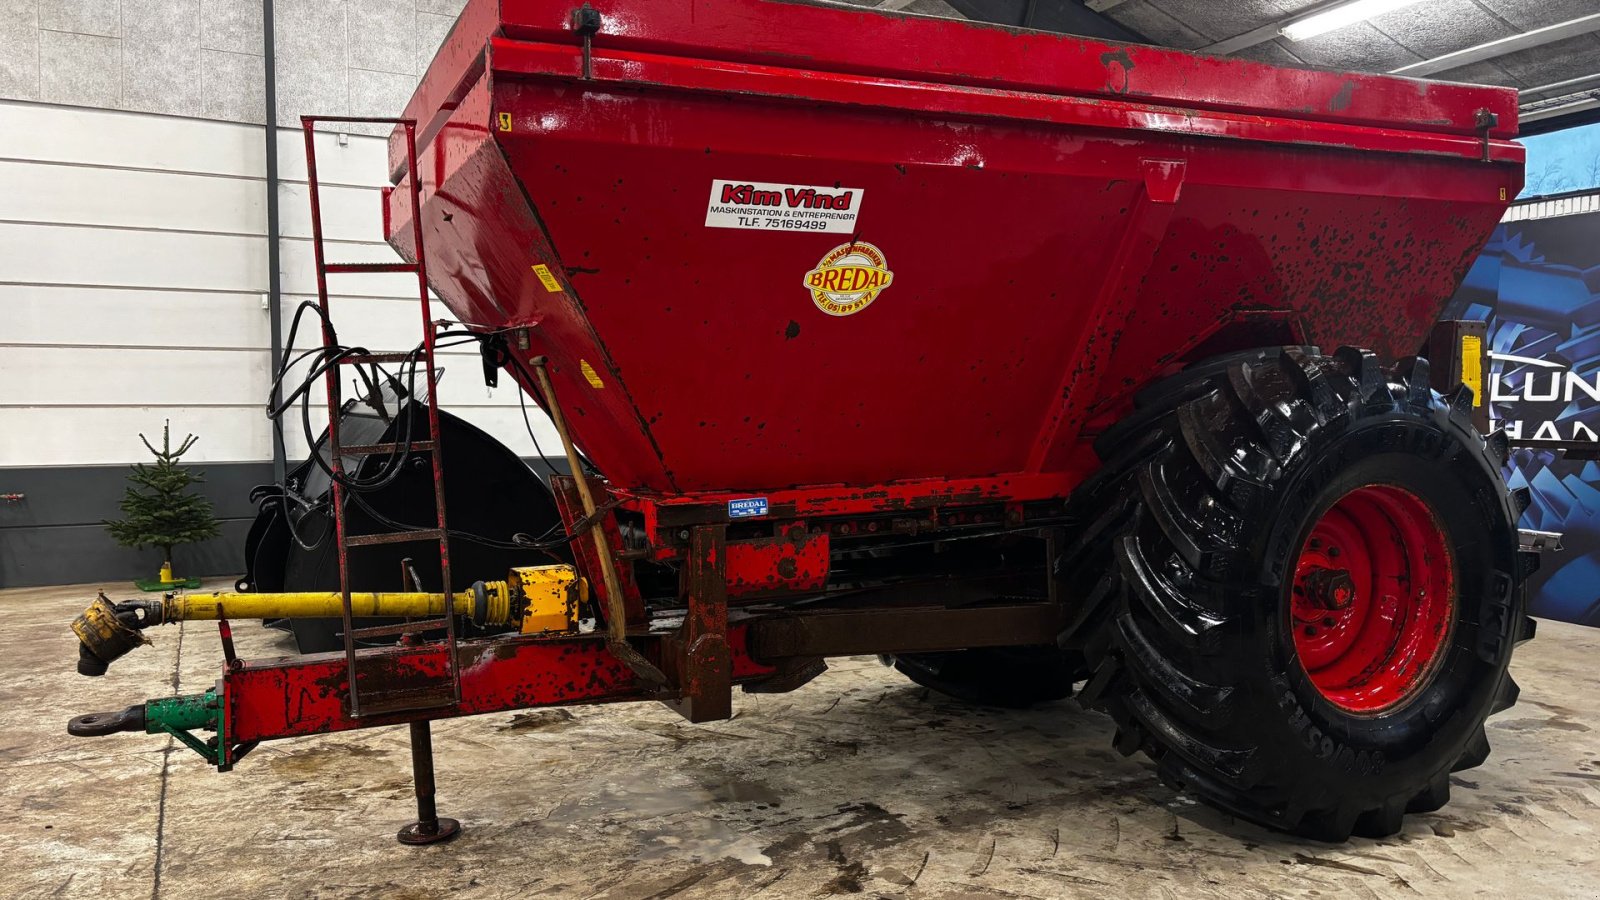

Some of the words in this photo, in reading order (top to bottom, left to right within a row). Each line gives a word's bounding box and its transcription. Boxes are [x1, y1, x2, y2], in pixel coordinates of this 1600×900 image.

[722, 185, 782, 206] Kim
[785, 188, 853, 211] Vind
[710, 206, 782, 217] MASKINSTATION
[792, 211, 856, 221] ENTREPRENØR
[738, 216, 760, 227] TLF.
[765, 218, 827, 230] 75169499
[810, 268, 889, 291] BREDAL
[841, 304, 853, 312] 89
[1488, 371, 1600, 402] LUN
